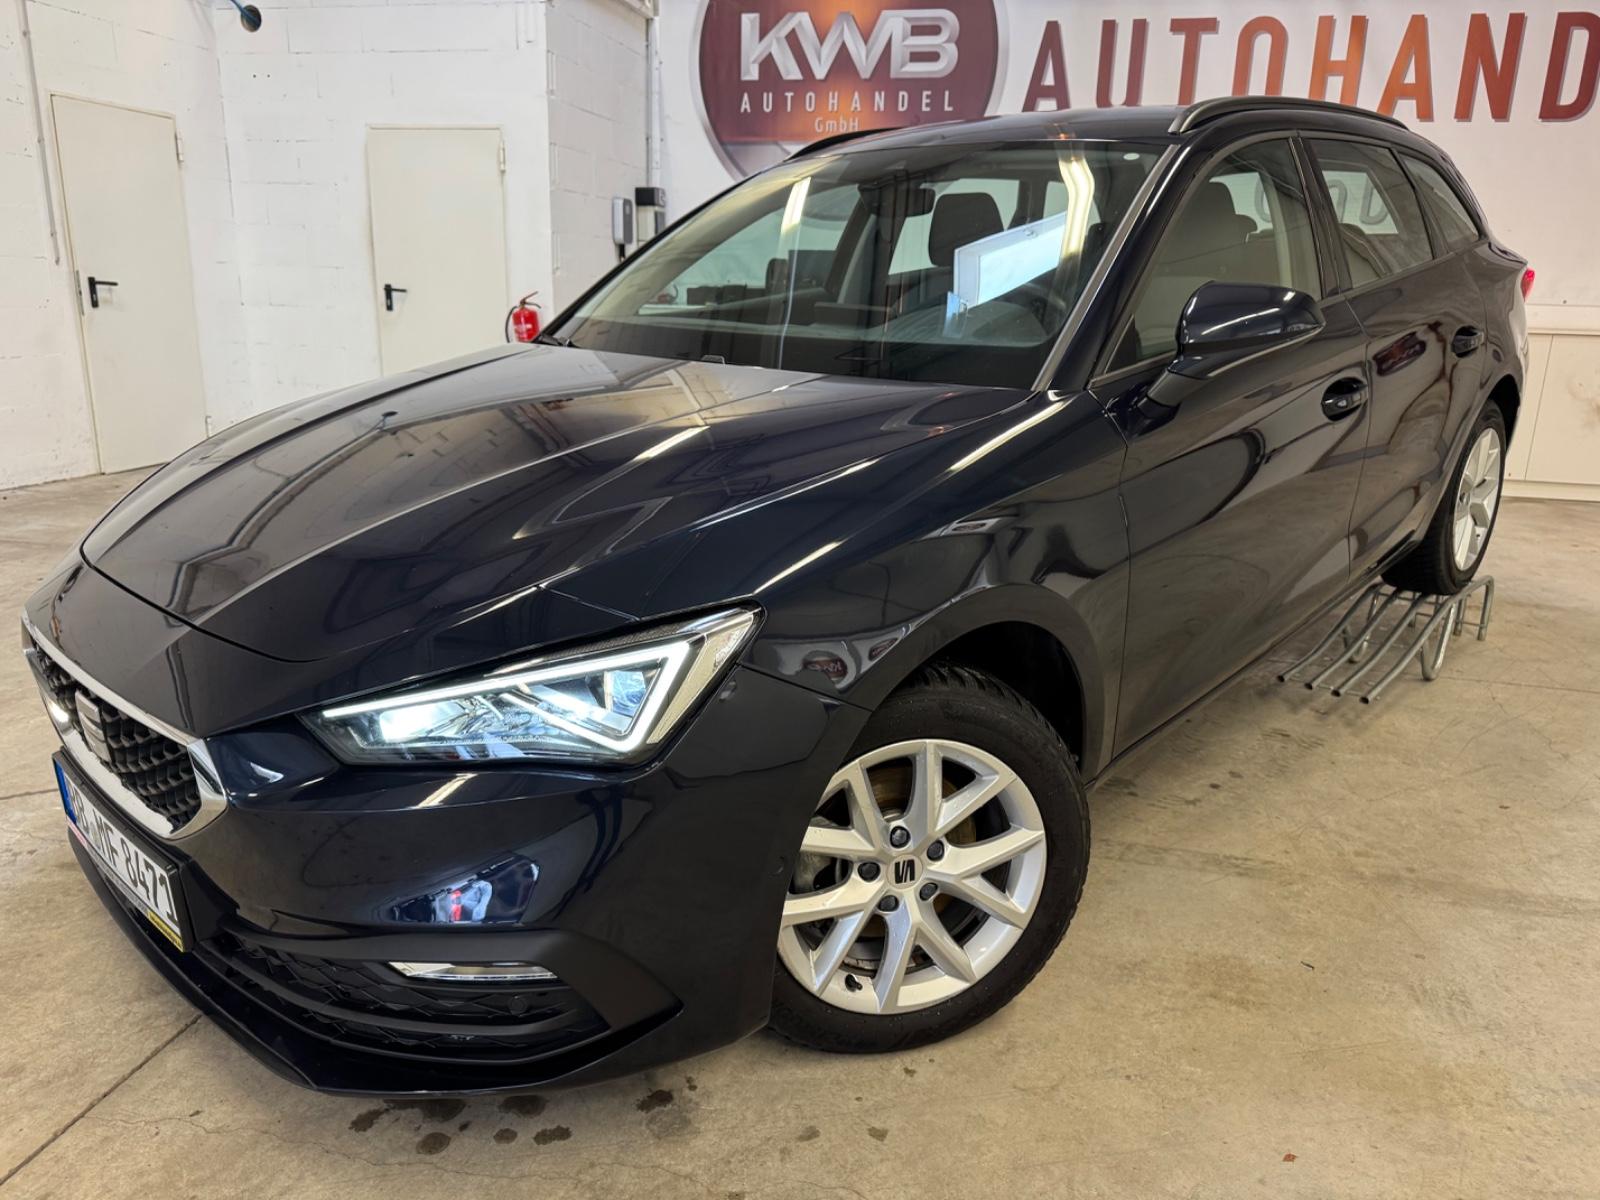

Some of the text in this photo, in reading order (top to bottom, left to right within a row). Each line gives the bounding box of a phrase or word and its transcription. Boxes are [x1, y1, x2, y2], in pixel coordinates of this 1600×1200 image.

[740, 8, 960, 81] KWB
[740, 89, 954, 113] AUTOHANDEL
[814, 117, 859, 133] GmbH
[121, 837, 180, 926] 8471
